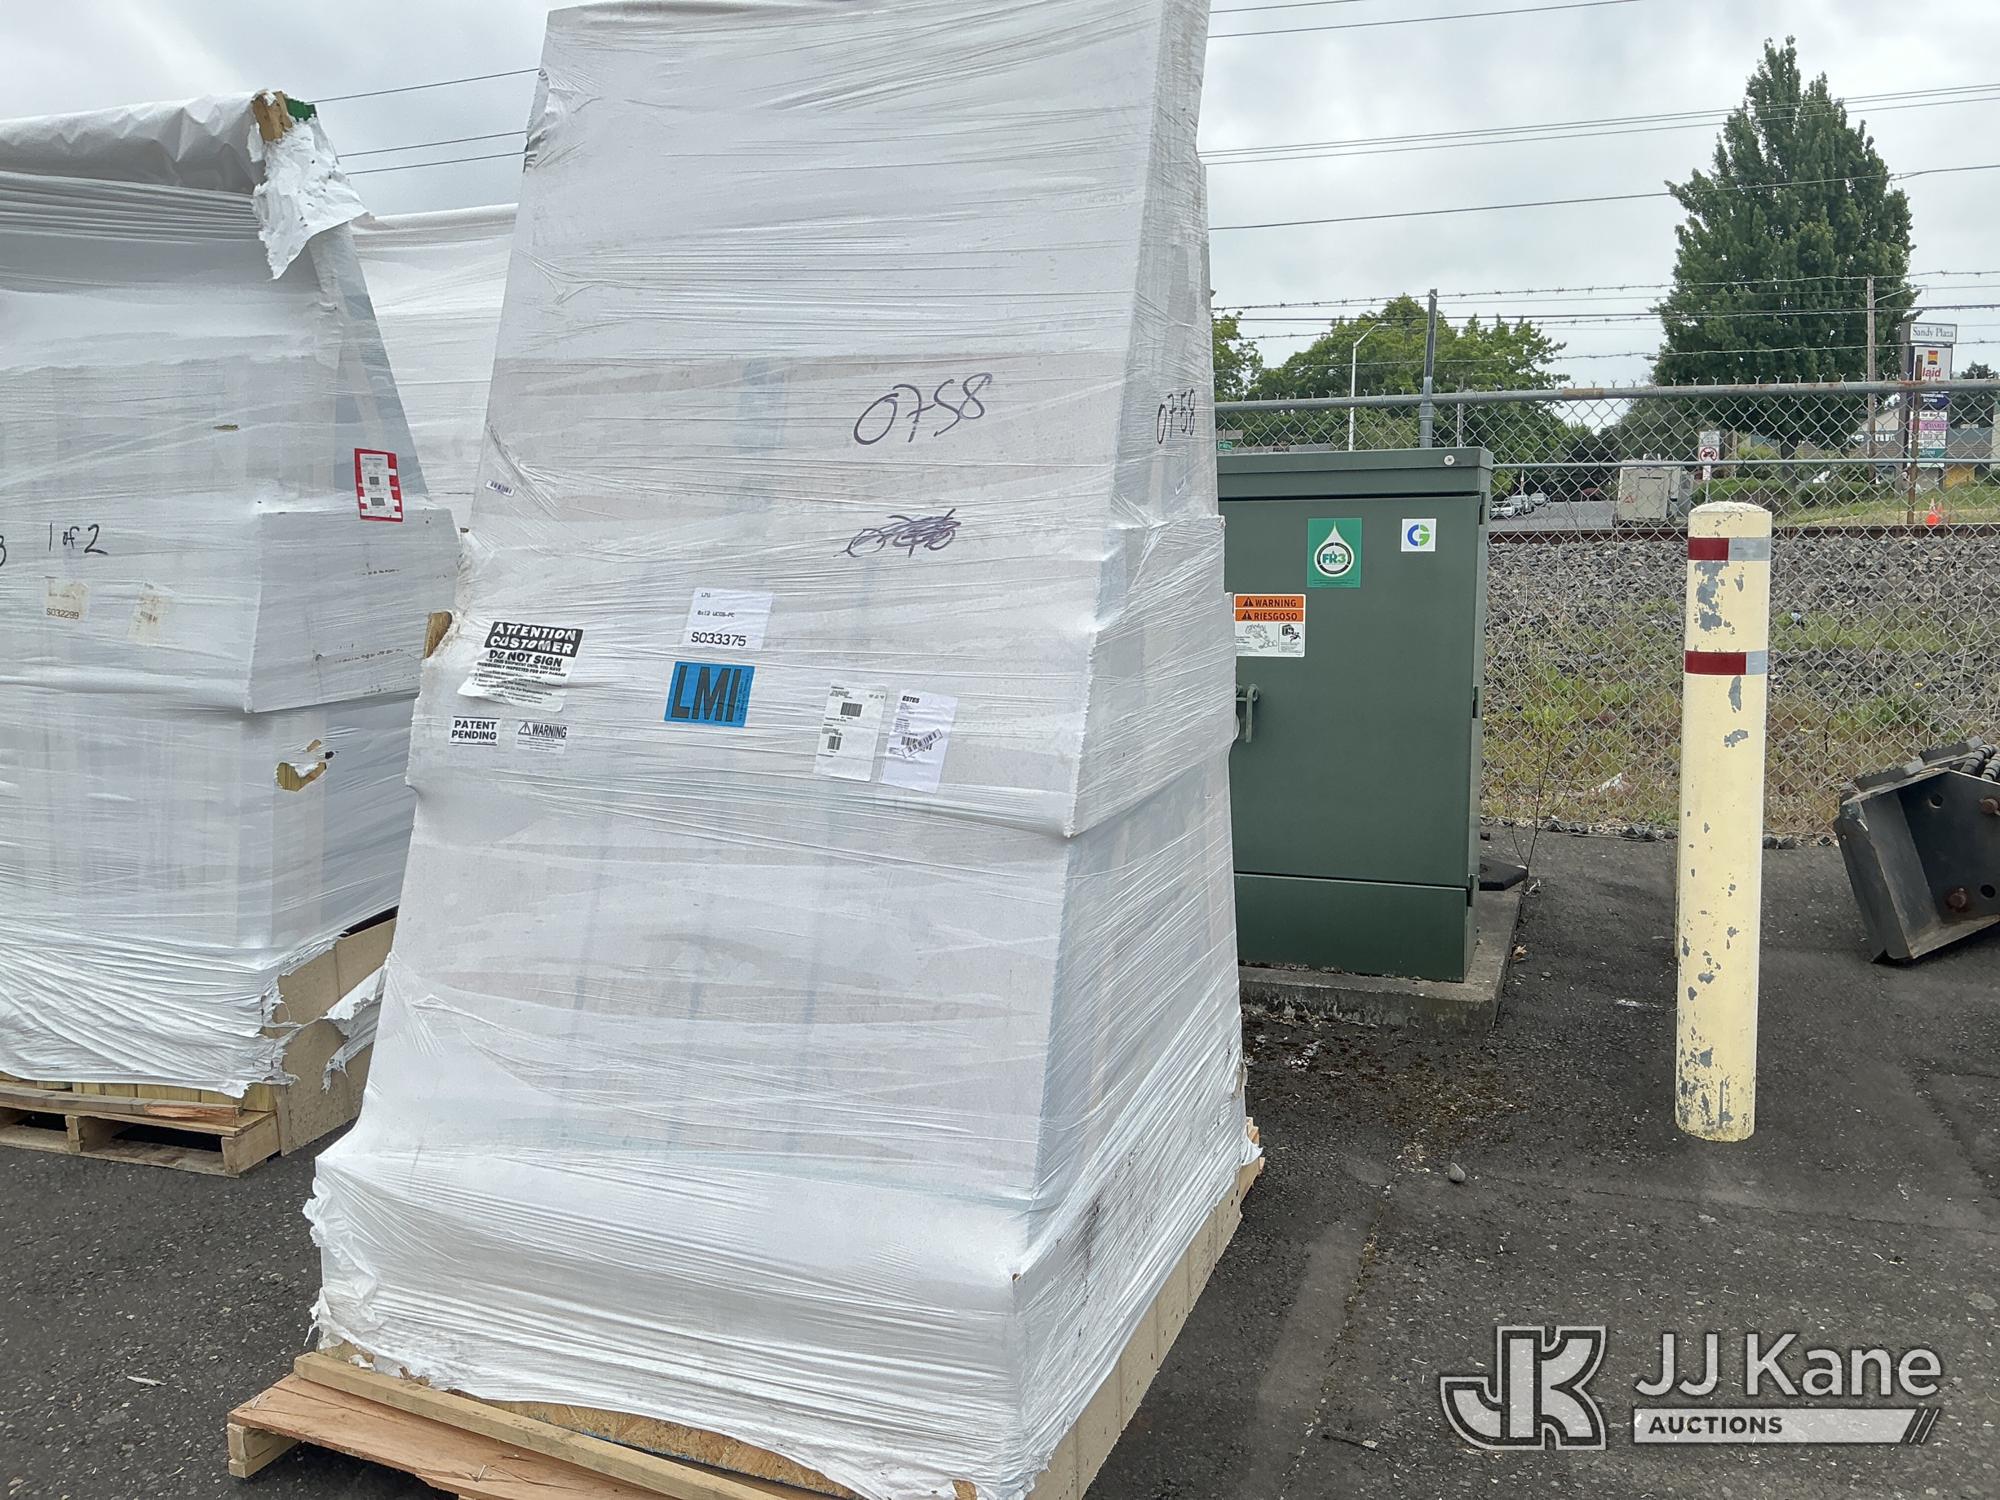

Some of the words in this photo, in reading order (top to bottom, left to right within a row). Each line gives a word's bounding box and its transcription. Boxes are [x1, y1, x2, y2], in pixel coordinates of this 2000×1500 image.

[1912, 326, 1933, 337] Sandy
[1935, 327, 1954, 338] Plaza
[853, 373, 993, 445] 0758
[1156, 388, 1196, 445] 0758
[48, 521, 53, 552] 1
[62, 526, 80, 550] of
[83, 524, 109, 556] 2
[1322, 551, 1346, 564] FR3
[1255, 598, 1297, 608] WARNING
[1253, 612, 1298, 621] RIESGOSO
[494, 623, 577, 642] ATTENTION
[490, 635, 573, 654] CUSTOMER
[489, 650, 505, 659] DO
[507, 651, 532, 661] NOT
[533, 655, 563, 667] SIGN
[671, 665, 742, 722] LMI
[901, 695, 920, 704] ESTES
[454, 720, 497, 730] PATENT
[531, 723, 568, 738] WARNING
[451, 730, 497, 740] PENDING
